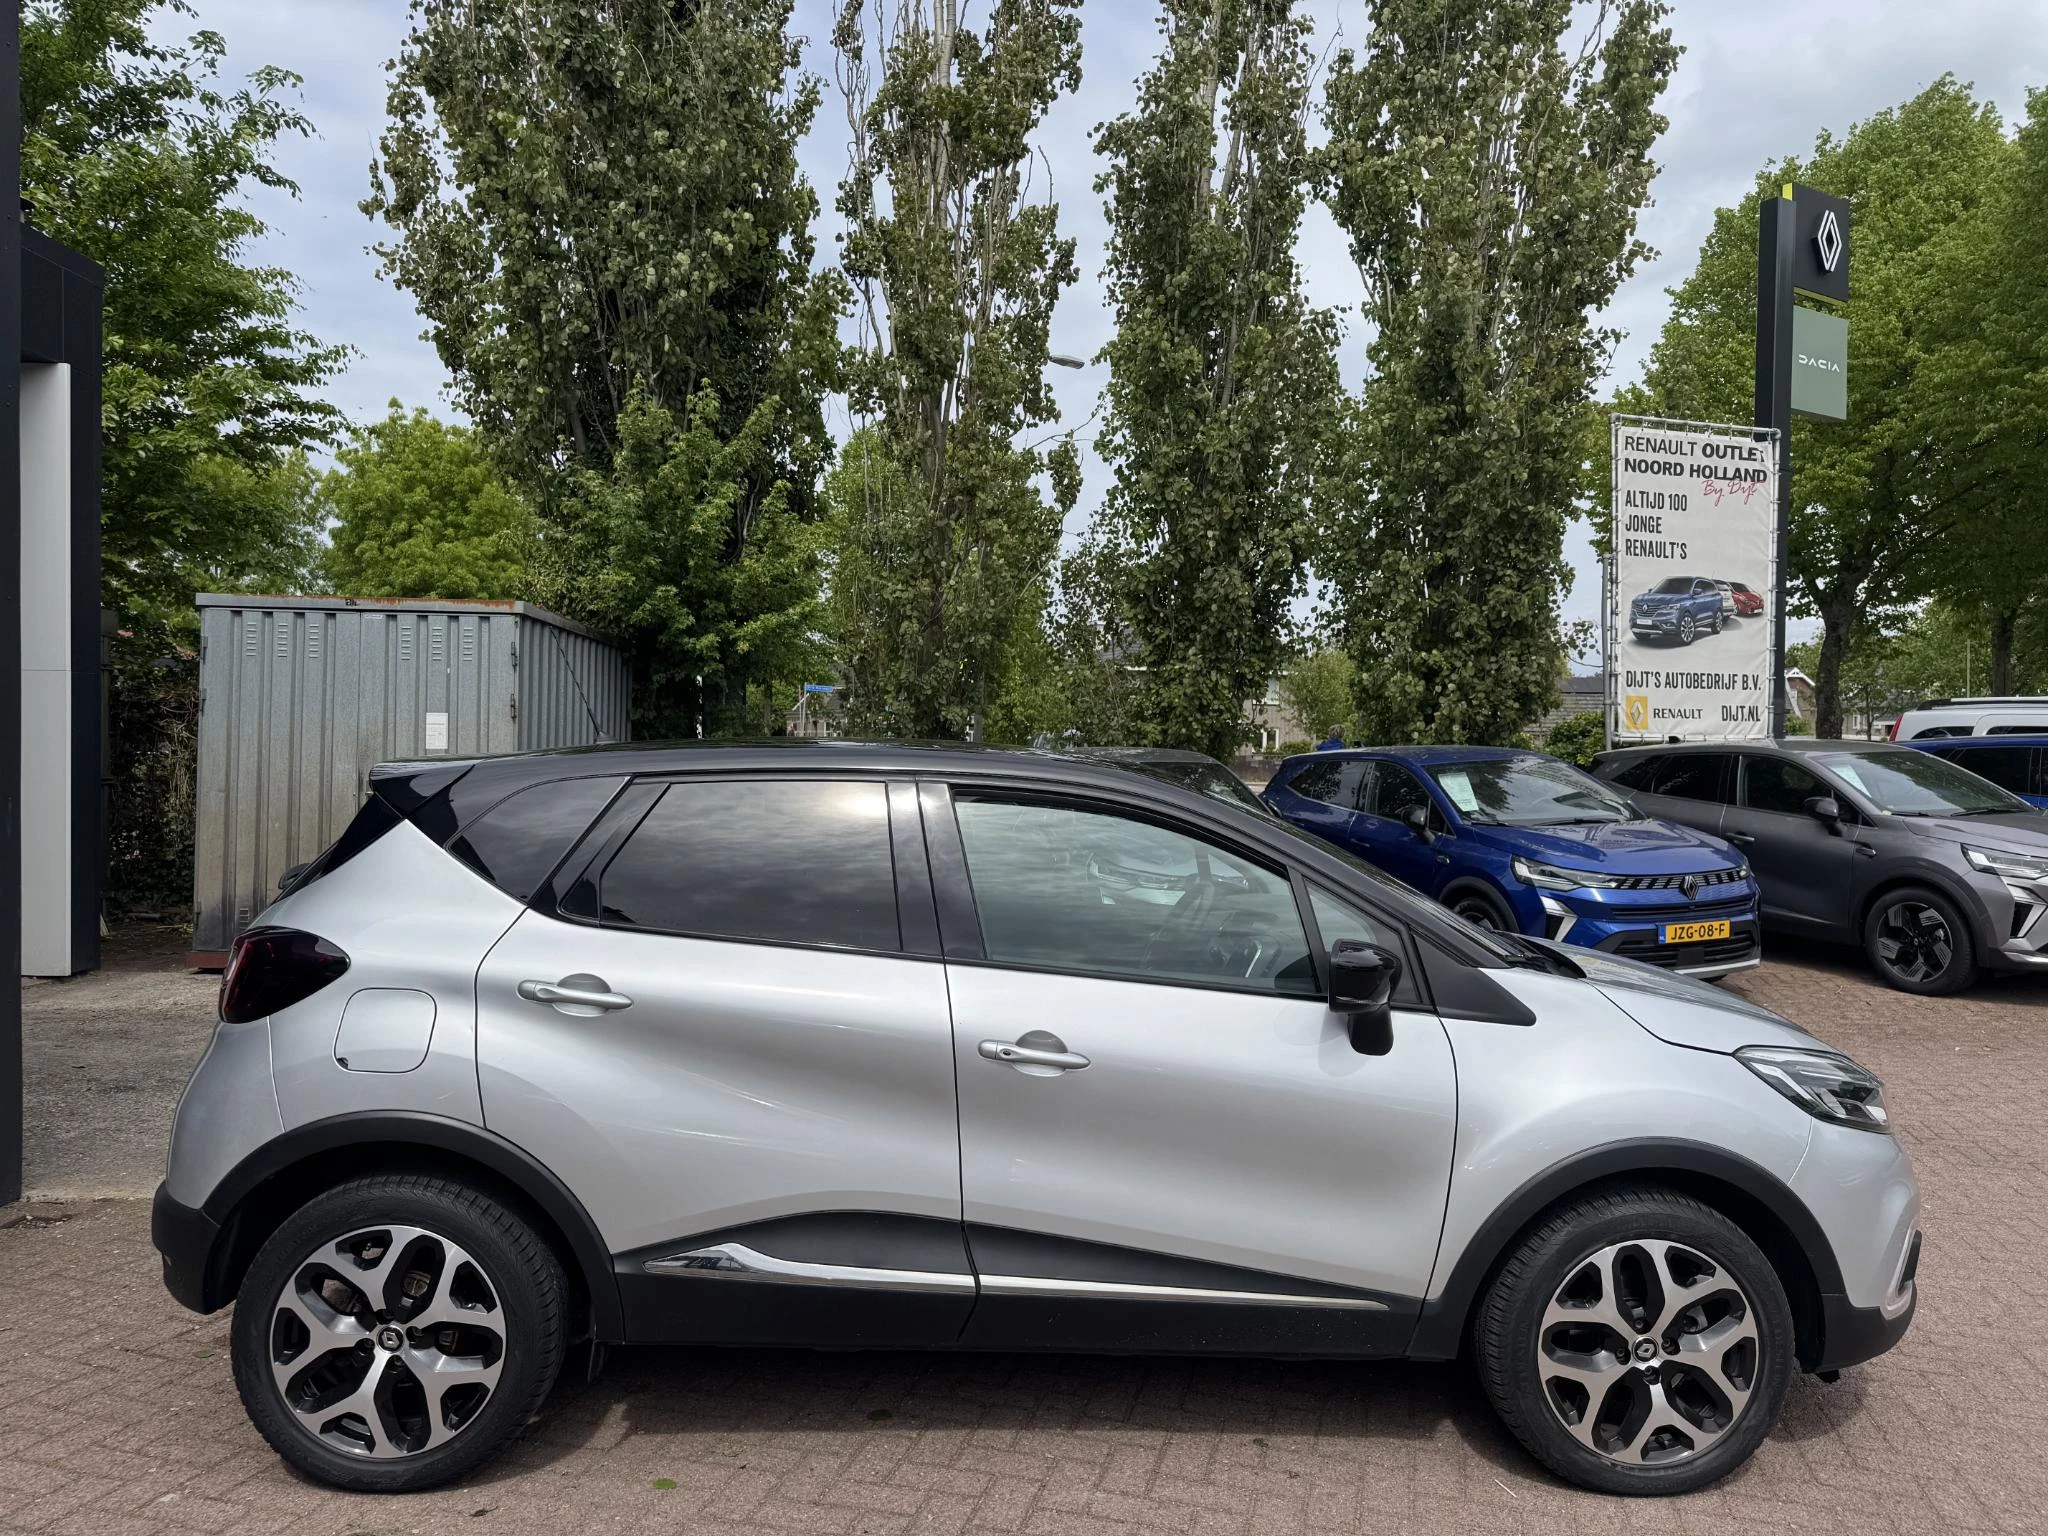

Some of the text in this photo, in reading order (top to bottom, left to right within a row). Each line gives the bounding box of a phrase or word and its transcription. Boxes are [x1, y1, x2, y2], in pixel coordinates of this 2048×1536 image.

[1798, 354, 1840, 373] DACIA
[1624, 436, 1697, 456] RENAULT
[1624, 458, 1768, 483] NOORD HOLLAND
[1625, 490, 1688, 511] ALTIJD 100
[1702, 480, 1724, 507] By
[1625, 514, 1662, 534] JONGE
[1625, 538, 1688, 560] RENAULT'S
[1626, 670, 1762, 691] DIJT'S AUTOBEDRIJF B.V.
[1653, 705, 1761, 722] RENAULT DIJT.NL
[1671, 924, 1725, 940] JZG-08-F
